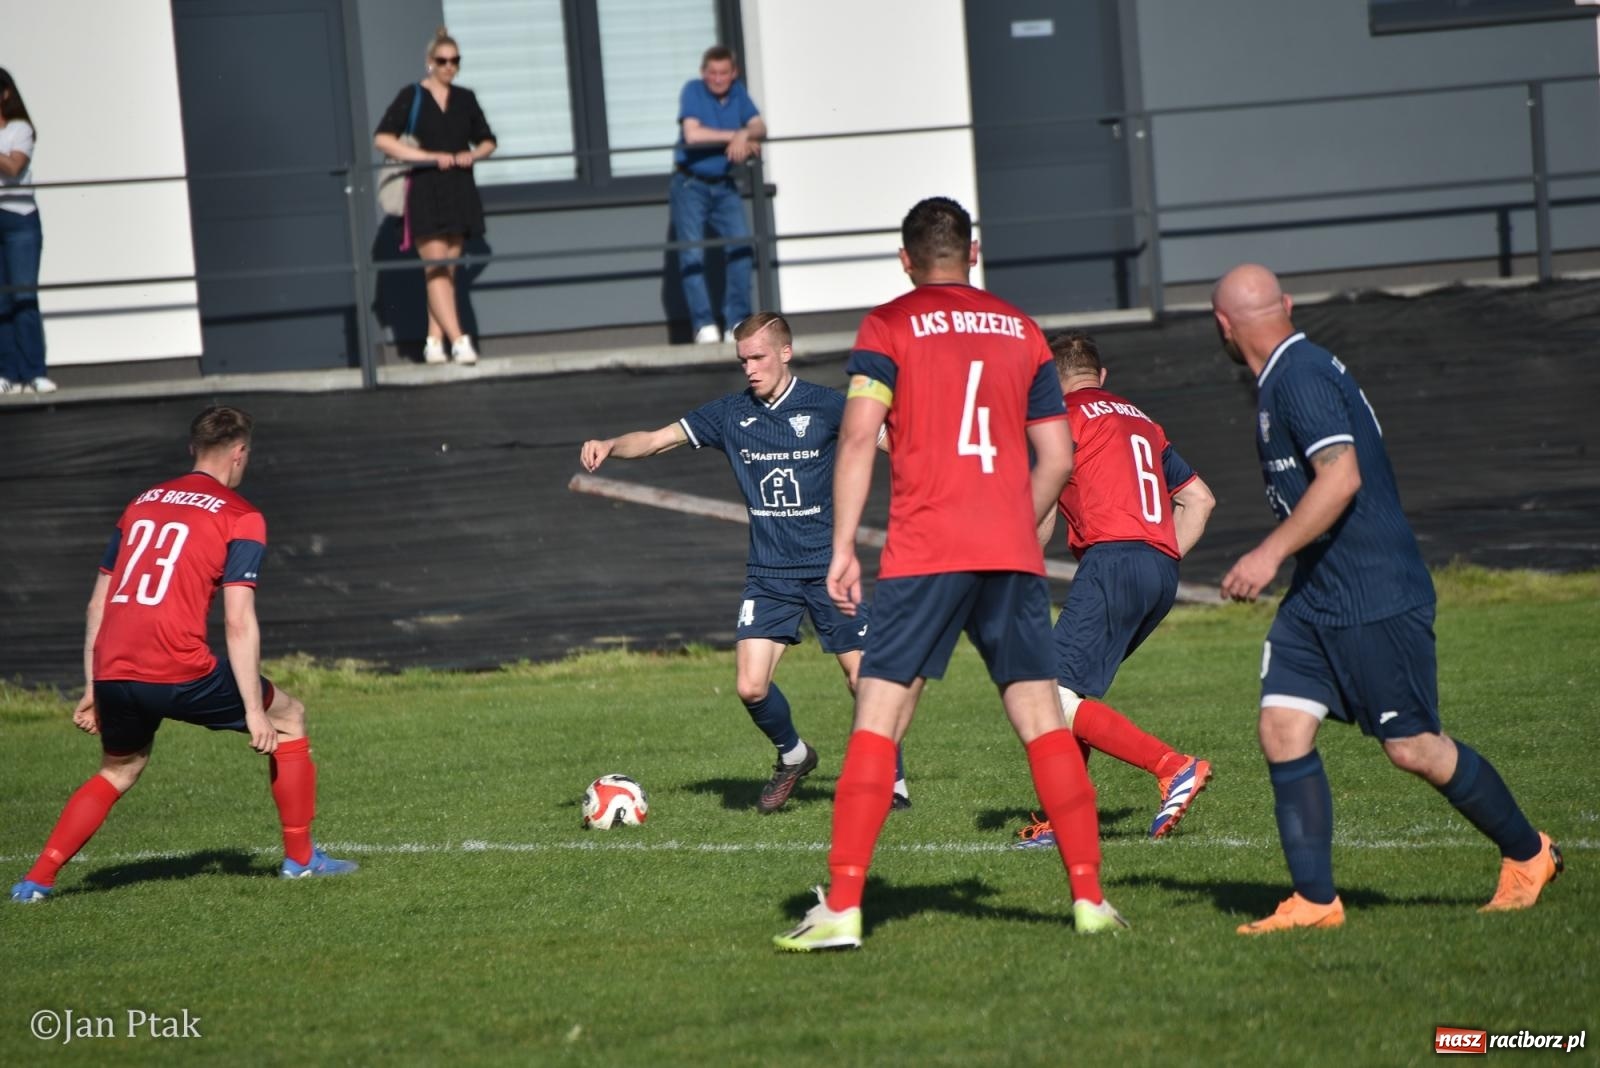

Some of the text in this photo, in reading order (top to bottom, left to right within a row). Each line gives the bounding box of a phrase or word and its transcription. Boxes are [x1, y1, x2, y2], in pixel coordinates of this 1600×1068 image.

[910, 310, 1025, 340] LKS BRZEZIE
[957, 360, 997, 474] 4
[1080, 400, 1154, 424] LKS BRZ
[751, 449, 820, 461] MASTER GSM
[1130, 433, 1162, 524] 6
[135, 488, 226, 513] LKS BRZEZIE
[786, 505, 821, 517] Lisowski
[110, 519, 190, 606] 23
